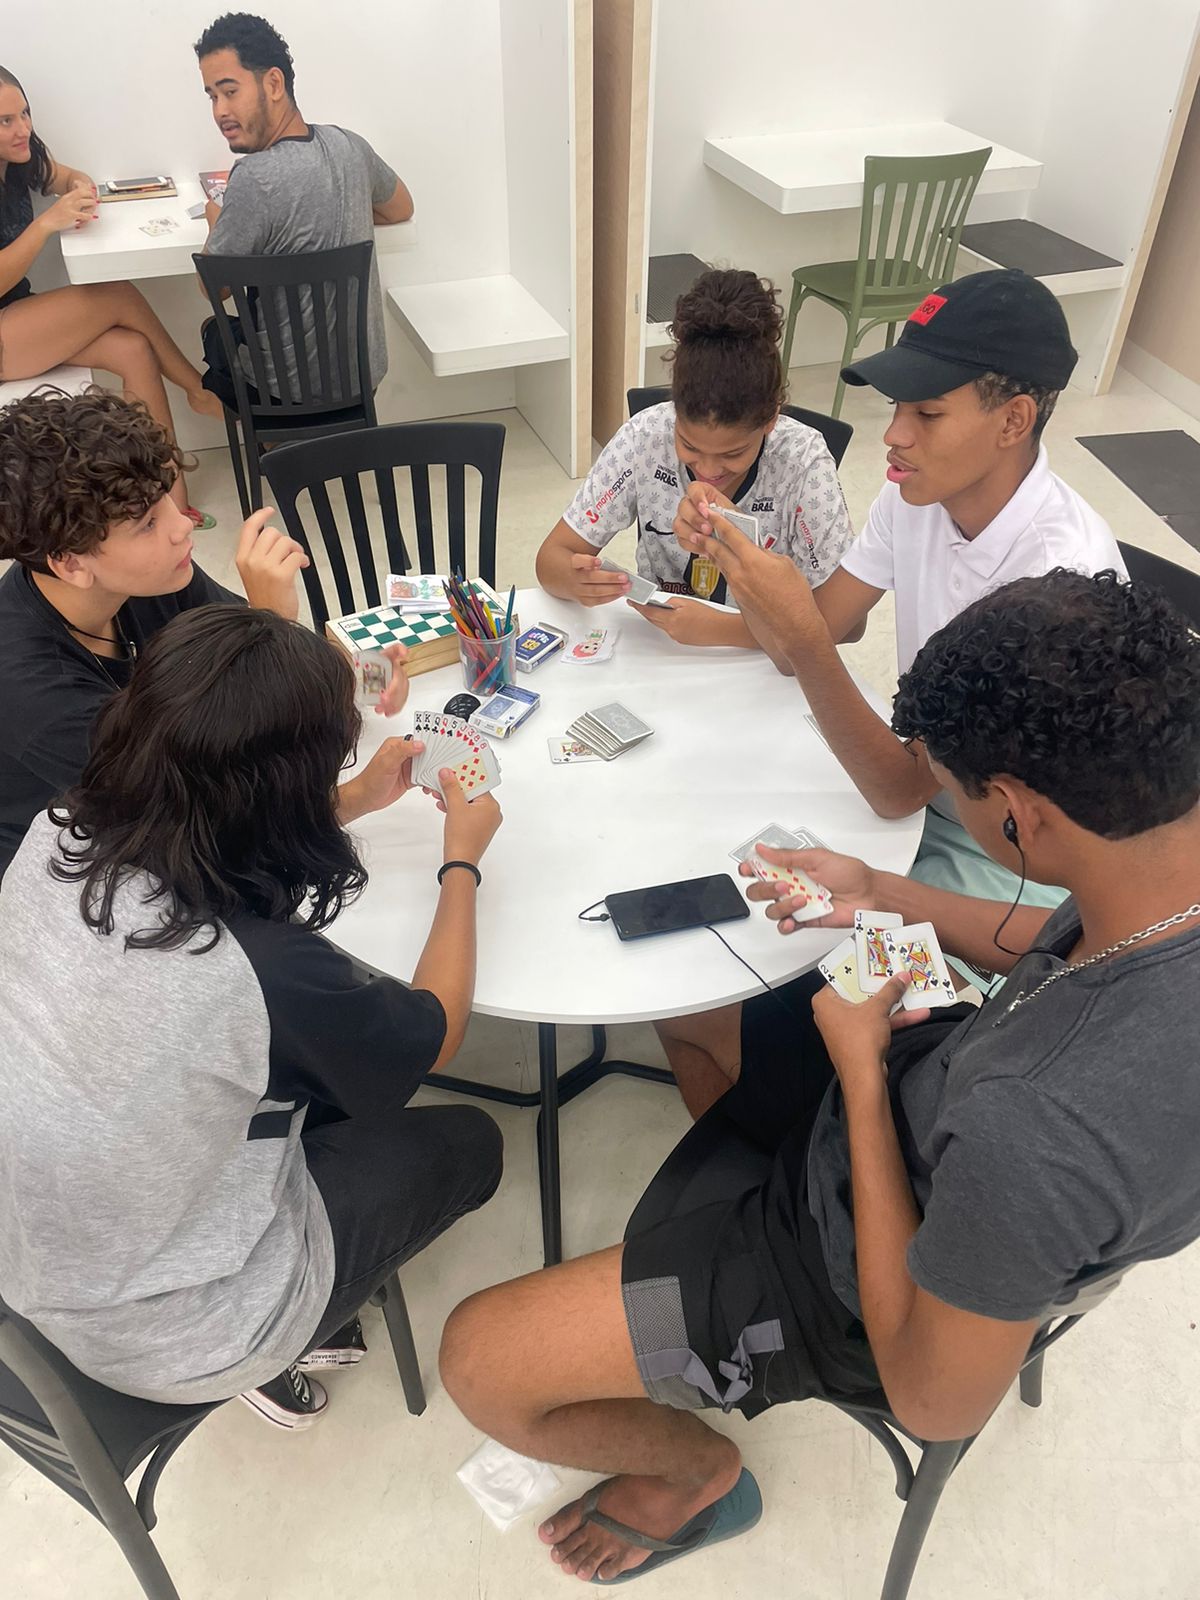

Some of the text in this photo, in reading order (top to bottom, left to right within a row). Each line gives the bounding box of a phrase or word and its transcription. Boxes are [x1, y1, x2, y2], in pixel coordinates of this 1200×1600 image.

[656, 575, 697, 595] anco
[856, 912, 862, 922] J
[885, 932, 894, 943] Q
[820, 964, 829, 975] 2
